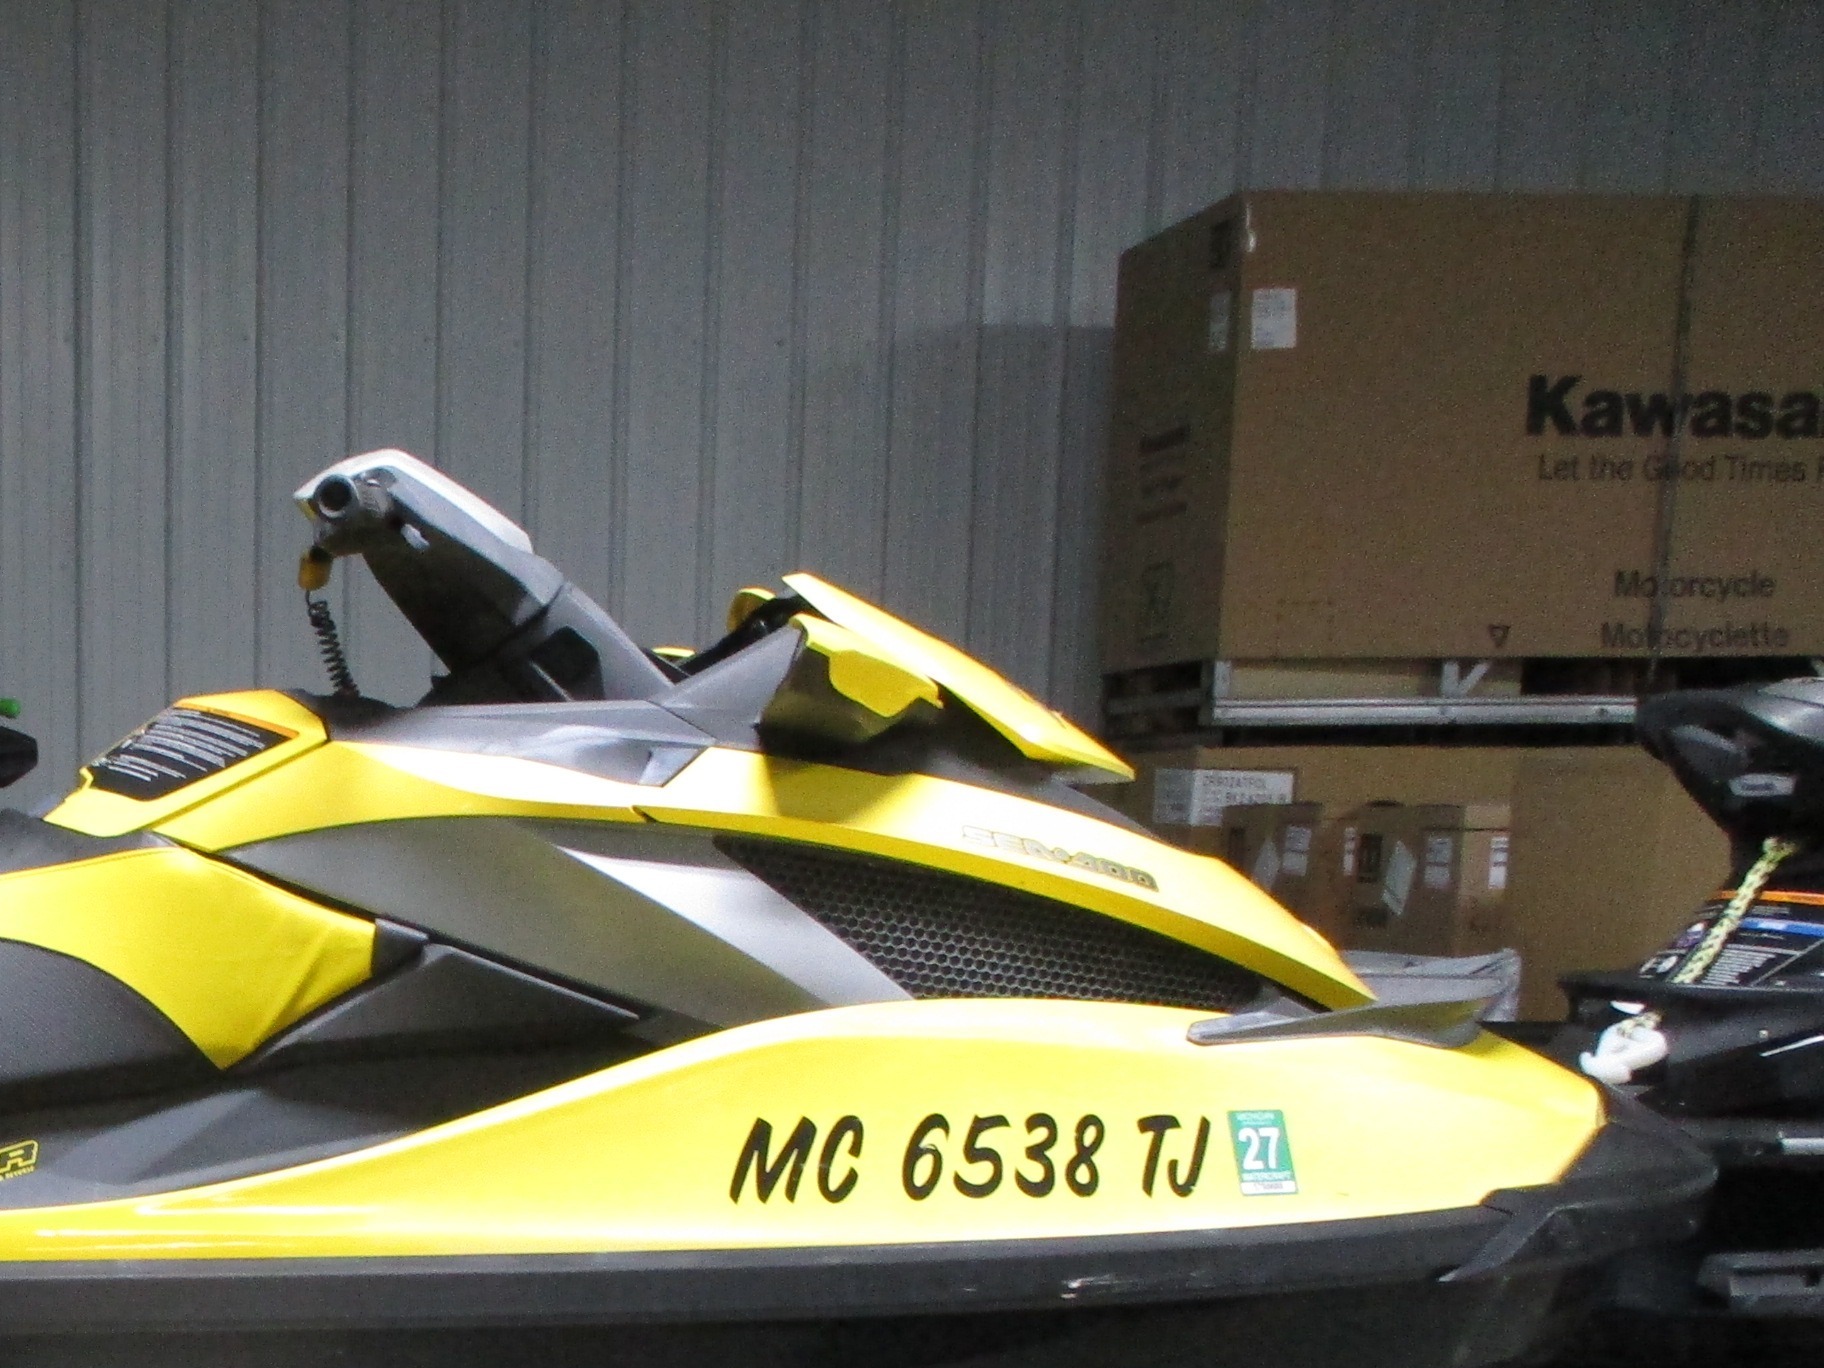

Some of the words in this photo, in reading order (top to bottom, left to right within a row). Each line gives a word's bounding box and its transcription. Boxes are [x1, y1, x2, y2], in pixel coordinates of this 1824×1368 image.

[1538, 455, 1579, 482] Let
[1590, 455, 1634, 482] the
[1643, 455, 1716, 482] God
[1725, 455, 1807, 483] Times
[1614, 570, 1776, 603] Moorcycle
[729, 1114, 865, 1205] MC
[902, 1112, 1106, 1202] 6538
[1137, 1114, 1211, 1199] TJ
[1237, 1126, 1280, 1170] 27
